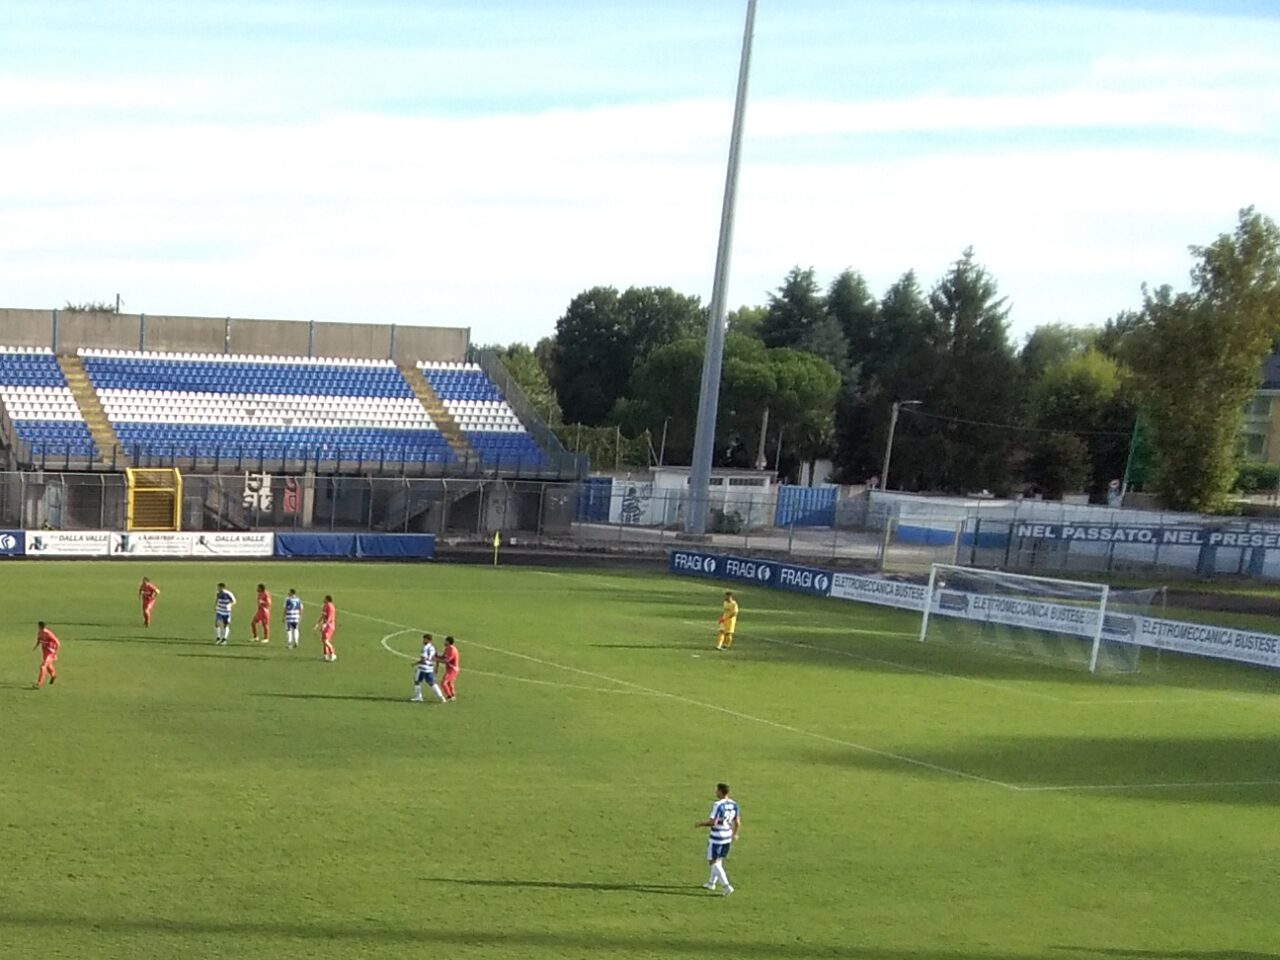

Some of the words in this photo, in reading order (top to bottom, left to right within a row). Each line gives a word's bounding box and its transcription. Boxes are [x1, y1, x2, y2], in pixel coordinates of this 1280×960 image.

[215, 535, 243, 543] DALLA
[244, 535, 266, 543] VALLE
[1018, 524, 1057, 539] NEL
[1061, 526, 1158, 544] PASSATO,
[1163, 530, 1204, 545] NEL
[1209, 532, 1280, 548] PRESE
[674, 552, 703, 571] FRAGI
[726, 559, 756, 579] FRAGI
[780, 567, 813, 589] FRAGI
[833, 572, 895, 597] ELETTROMECCANICA
[894, 582, 925, 601] BUSTESE
[973, 596, 1050, 620] ELETTROMECCANICA
[1142, 619, 1233, 645] ELETTROMECCANICA
[1234, 632, 1278, 654] BUSTESE
